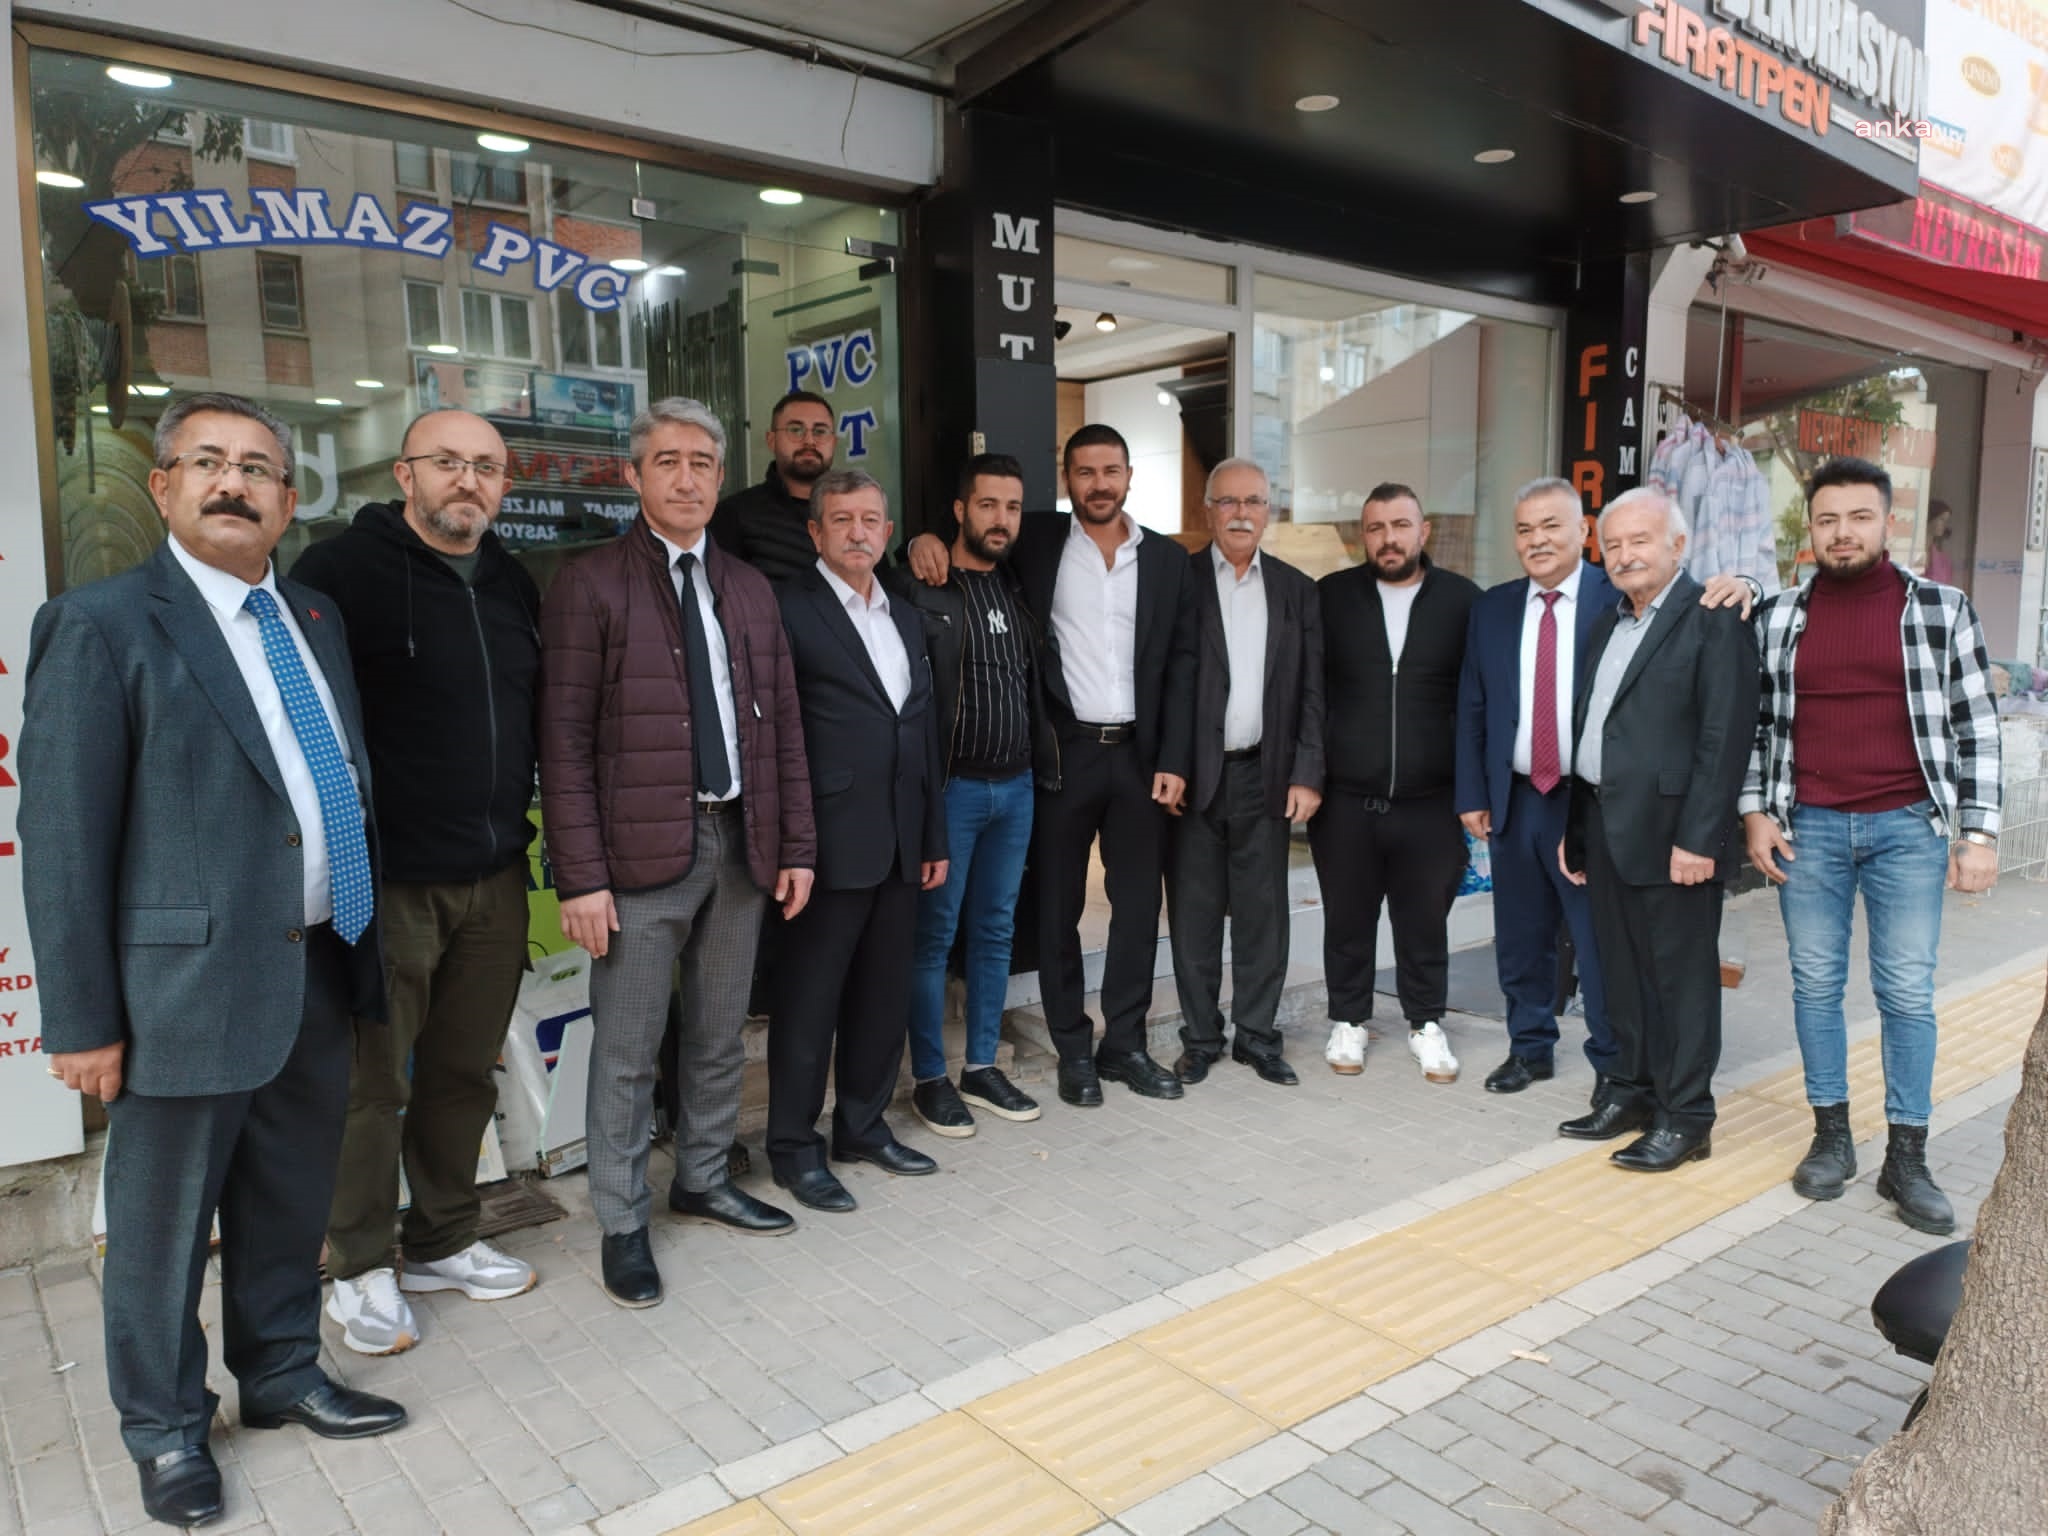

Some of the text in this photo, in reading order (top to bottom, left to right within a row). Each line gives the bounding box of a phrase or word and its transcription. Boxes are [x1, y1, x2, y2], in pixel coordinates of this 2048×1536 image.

[84, 188, 629, 312] YILMAZ PVC
[784, 328, 878, 396] PVC
[1618, 347, 1640, 476] CAM
